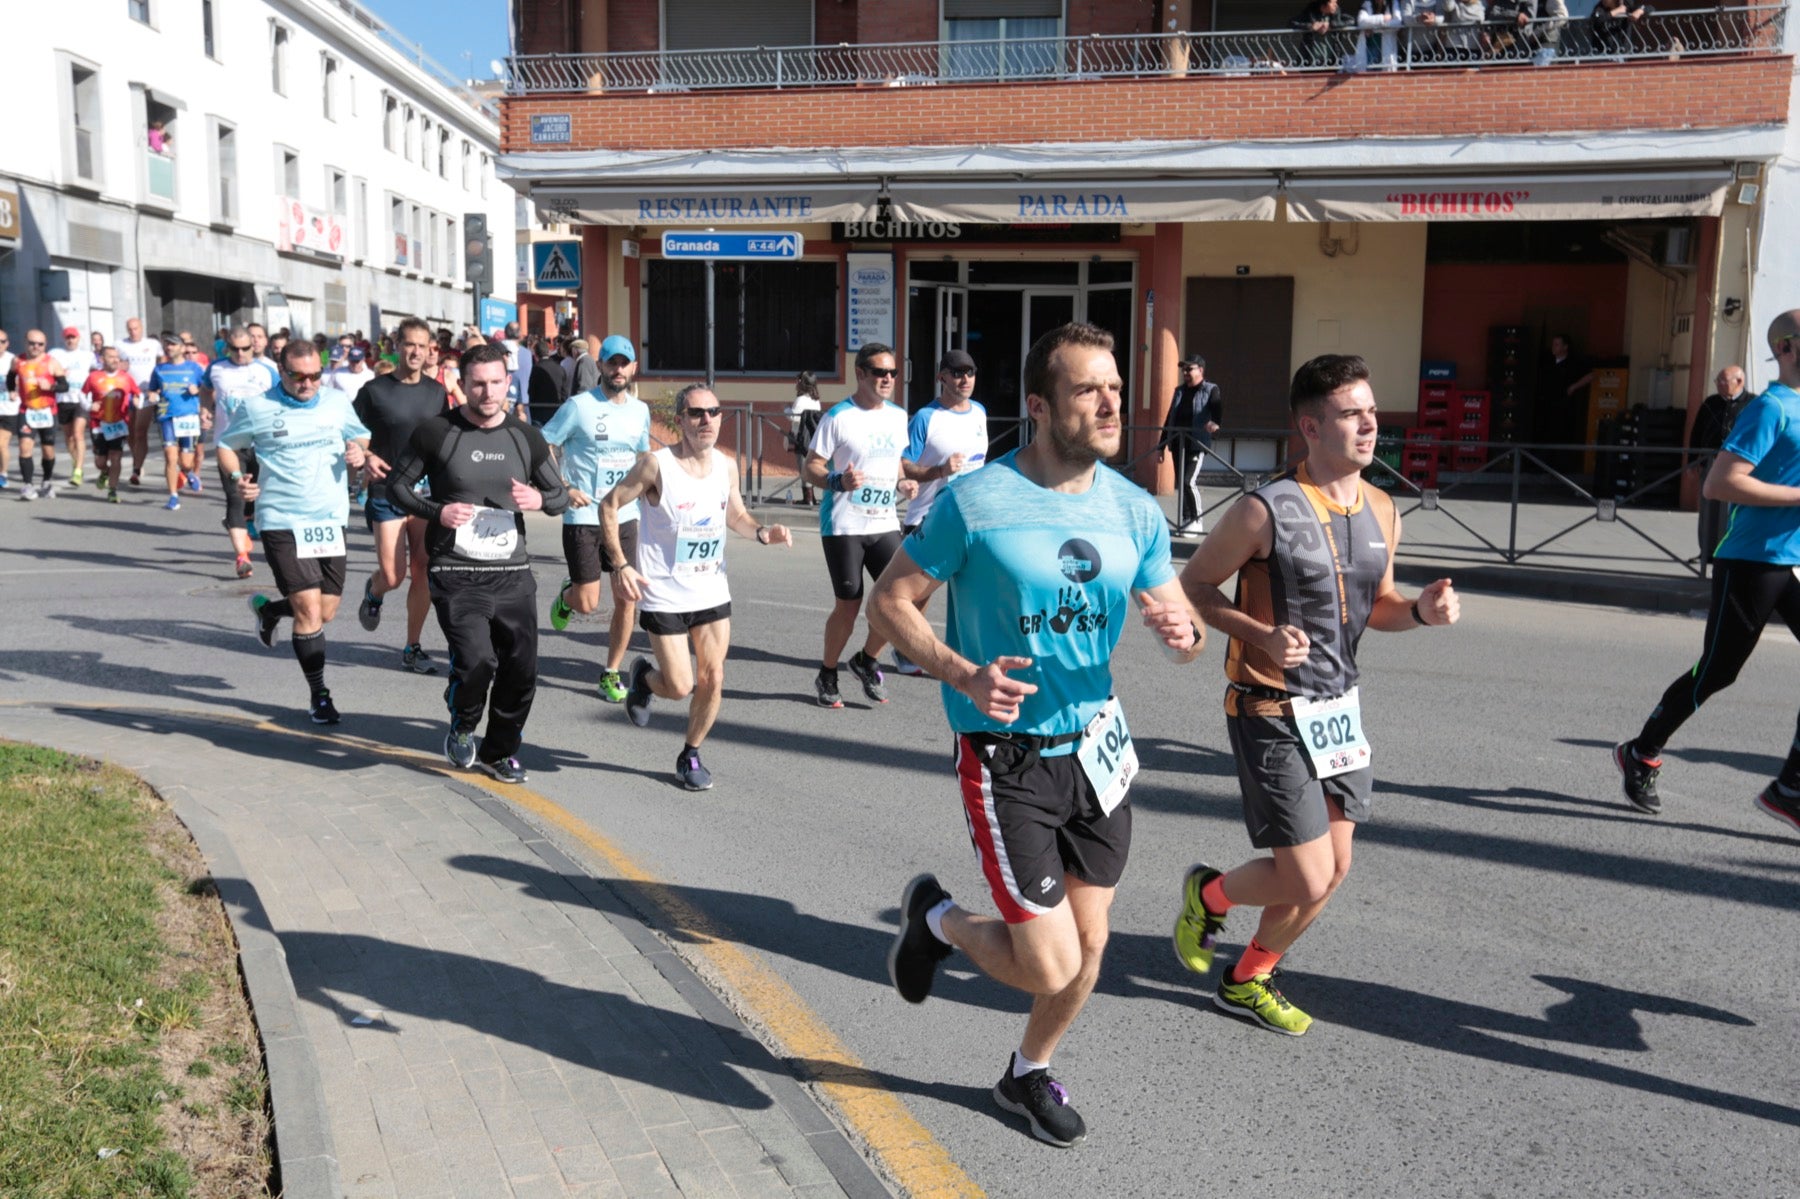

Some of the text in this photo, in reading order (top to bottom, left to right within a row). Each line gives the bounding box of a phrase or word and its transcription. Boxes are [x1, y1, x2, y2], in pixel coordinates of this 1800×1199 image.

[542, 123, 567, 132] JACOBO
[638, 197, 812, 220] RESTAURANTE
[1018, 194, 1129, 216] PARADA
[843, 221, 962, 239] BICHITOS
[666, 239, 720, 252] Granada
[858, 273, 886, 281] PARADA
[861, 488, 892, 505] 878
[304, 526, 335, 543] 893
[687, 540, 720, 560] 797
[1309, 714, 1356, 750] 802
[1097, 716, 1130, 775] 192
